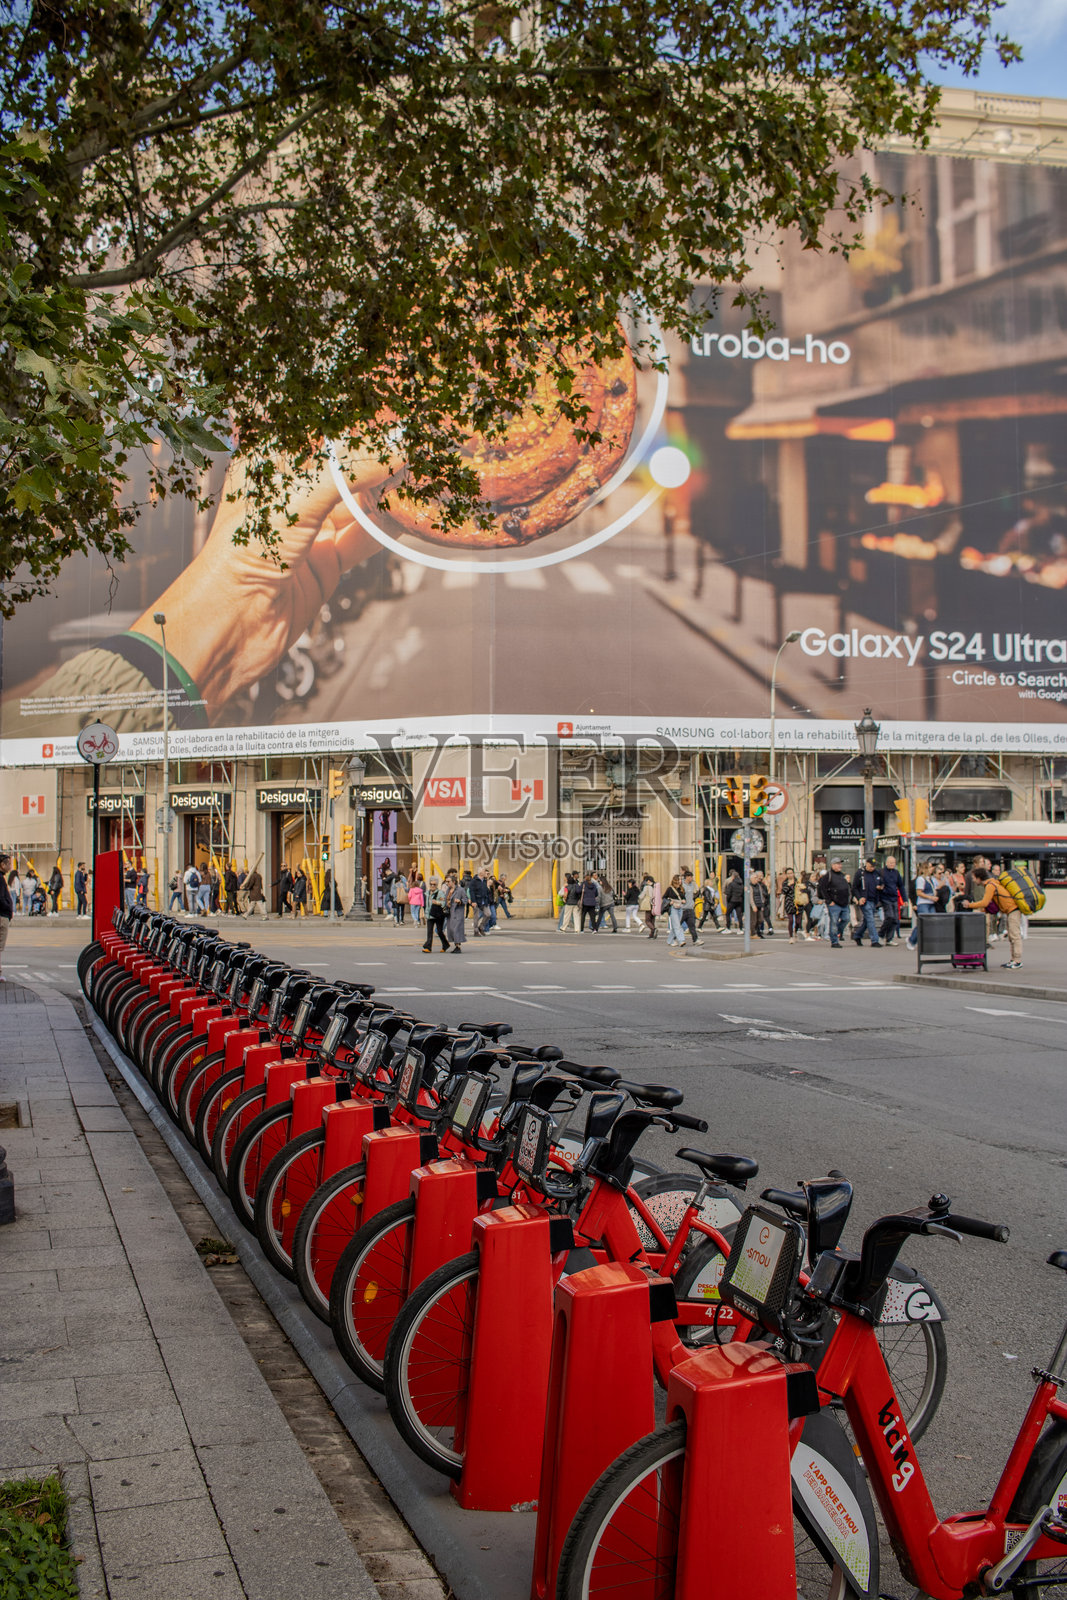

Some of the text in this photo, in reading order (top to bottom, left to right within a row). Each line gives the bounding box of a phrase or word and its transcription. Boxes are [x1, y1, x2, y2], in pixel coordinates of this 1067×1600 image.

[691, 327, 851, 365] troba-ho
[800, 627, 1067, 667] Galaxy S24 Ultra
[952, 670, 1067, 688] Circle to Search
[1018, 689, 1067, 701] with Google
[226, 733, 234, 741] la
[287, 729, 297, 739] de
[298, 729, 306, 738] la
[308, 728, 340, 740] mitgera
[656, 727, 715, 738] SAMSUNG
[778, 731, 791, 739] en
[794, 730, 803, 739] la
[807, 730, 857, 740] rehabilita
[892, 731, 902, 740] la
[905, 732, 945, 744] mitgera
[947, 732, 960, 742] de
[963, 732, 972, 742] la
[975, 733, 988, 744] pl.
[990, 733, 1003, 742] de
[1005, 733, 1020, 743] les
[1023, 733, 1051, 744] Olles,
[127, 747, 134, 756] la
[146, 746, 156, 755] de
[192, 743, 228, 753] dedicada
[236, 743, 243, 751] la
[267, 740, 294, 750] contra
[295, 739, 307, 748] els
[309, 737, 355, 748] feminicidis
[89, 796, 136, 812] Dsigual.
[808, 1461, 859, 1534] L'APP QUE ET MOU
